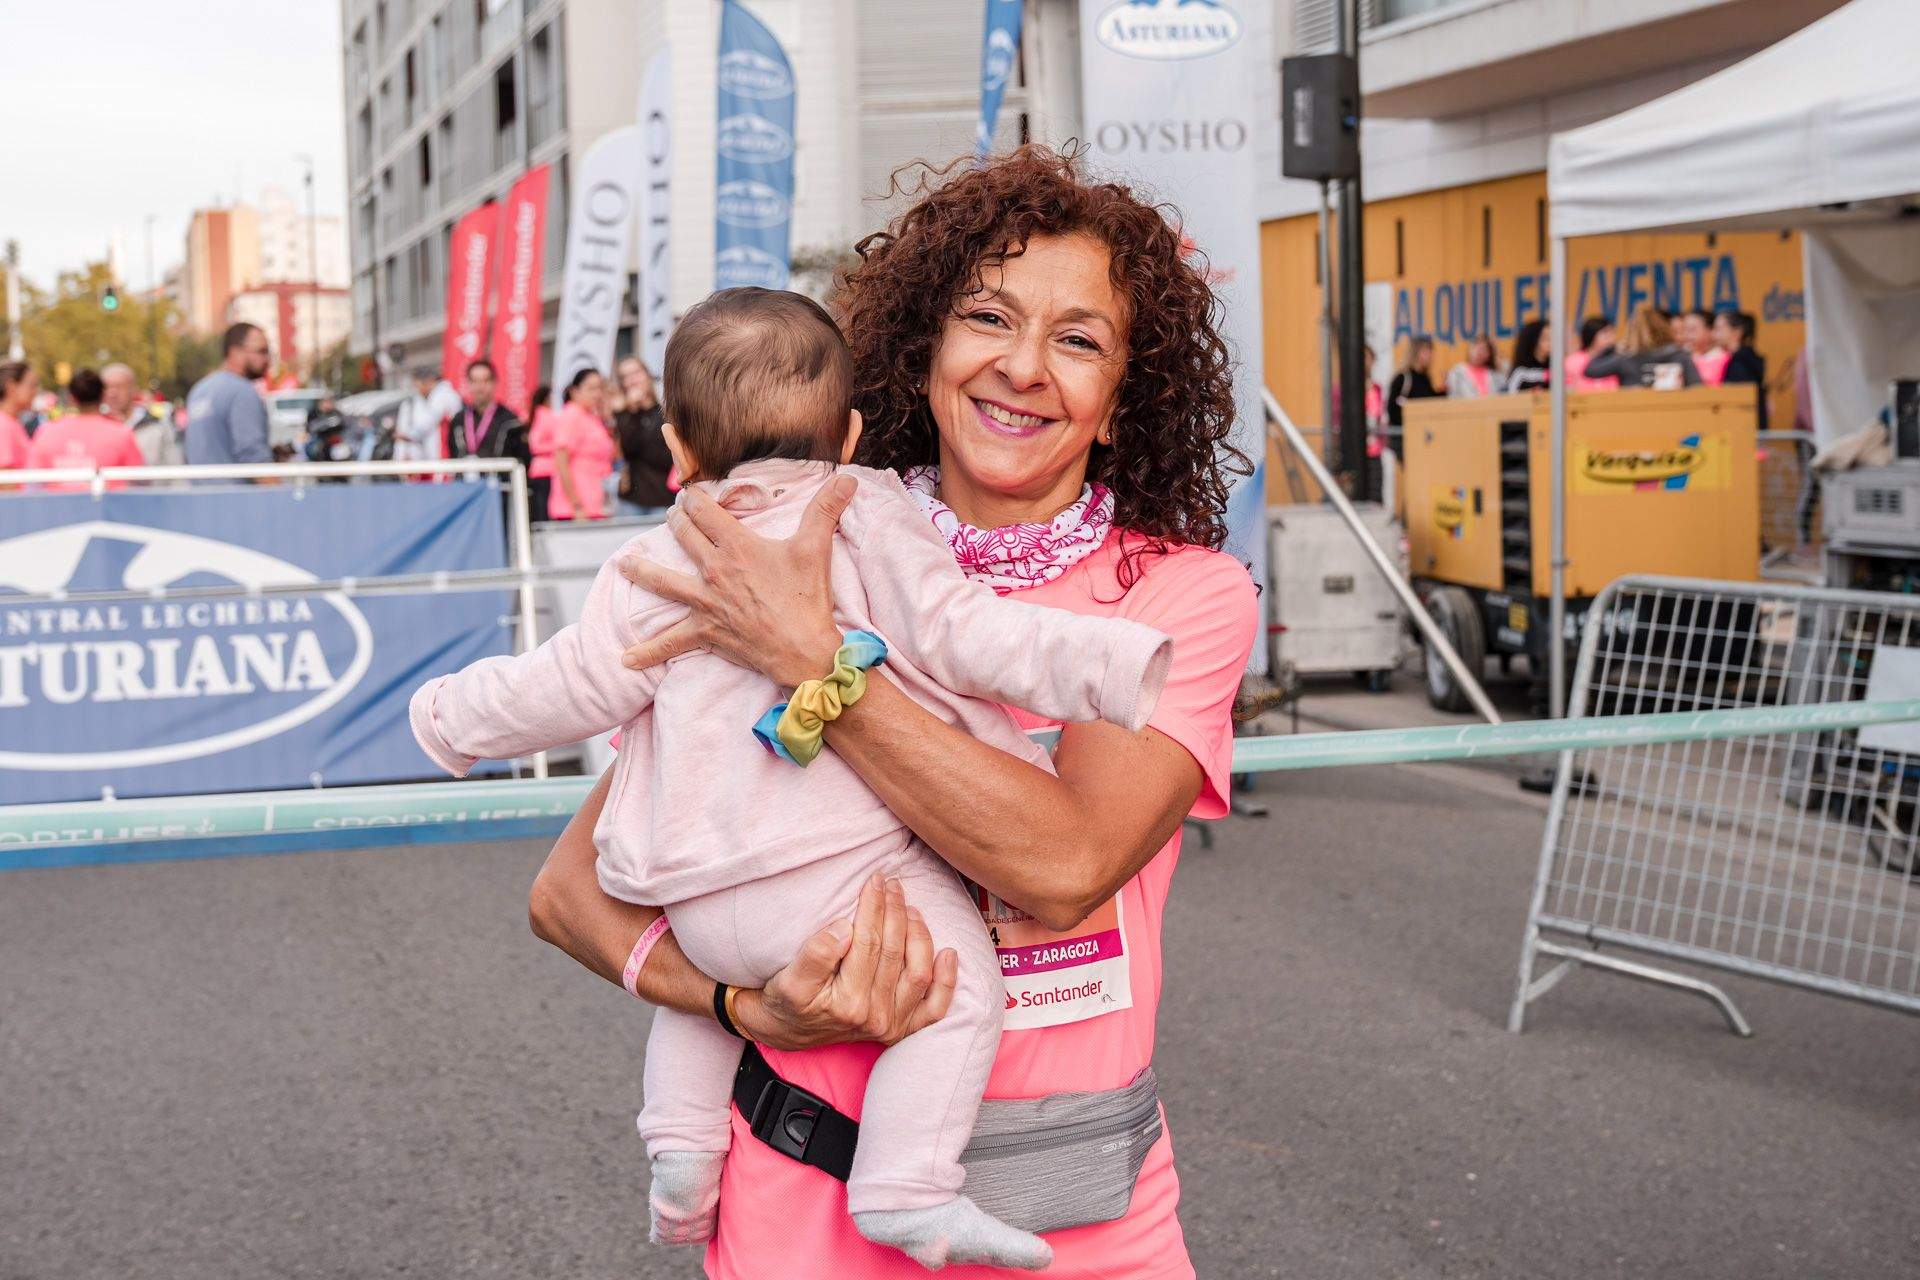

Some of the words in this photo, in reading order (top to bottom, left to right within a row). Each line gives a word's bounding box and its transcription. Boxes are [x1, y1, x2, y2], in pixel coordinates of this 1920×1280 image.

[1097, 118, 1247, 154] OYSHO
[141, 598, 314, 630] LECHERA
[1031, 940, 1100, 965] ZARAGOZA
[1021, 980, 1103, 1007] Santander
